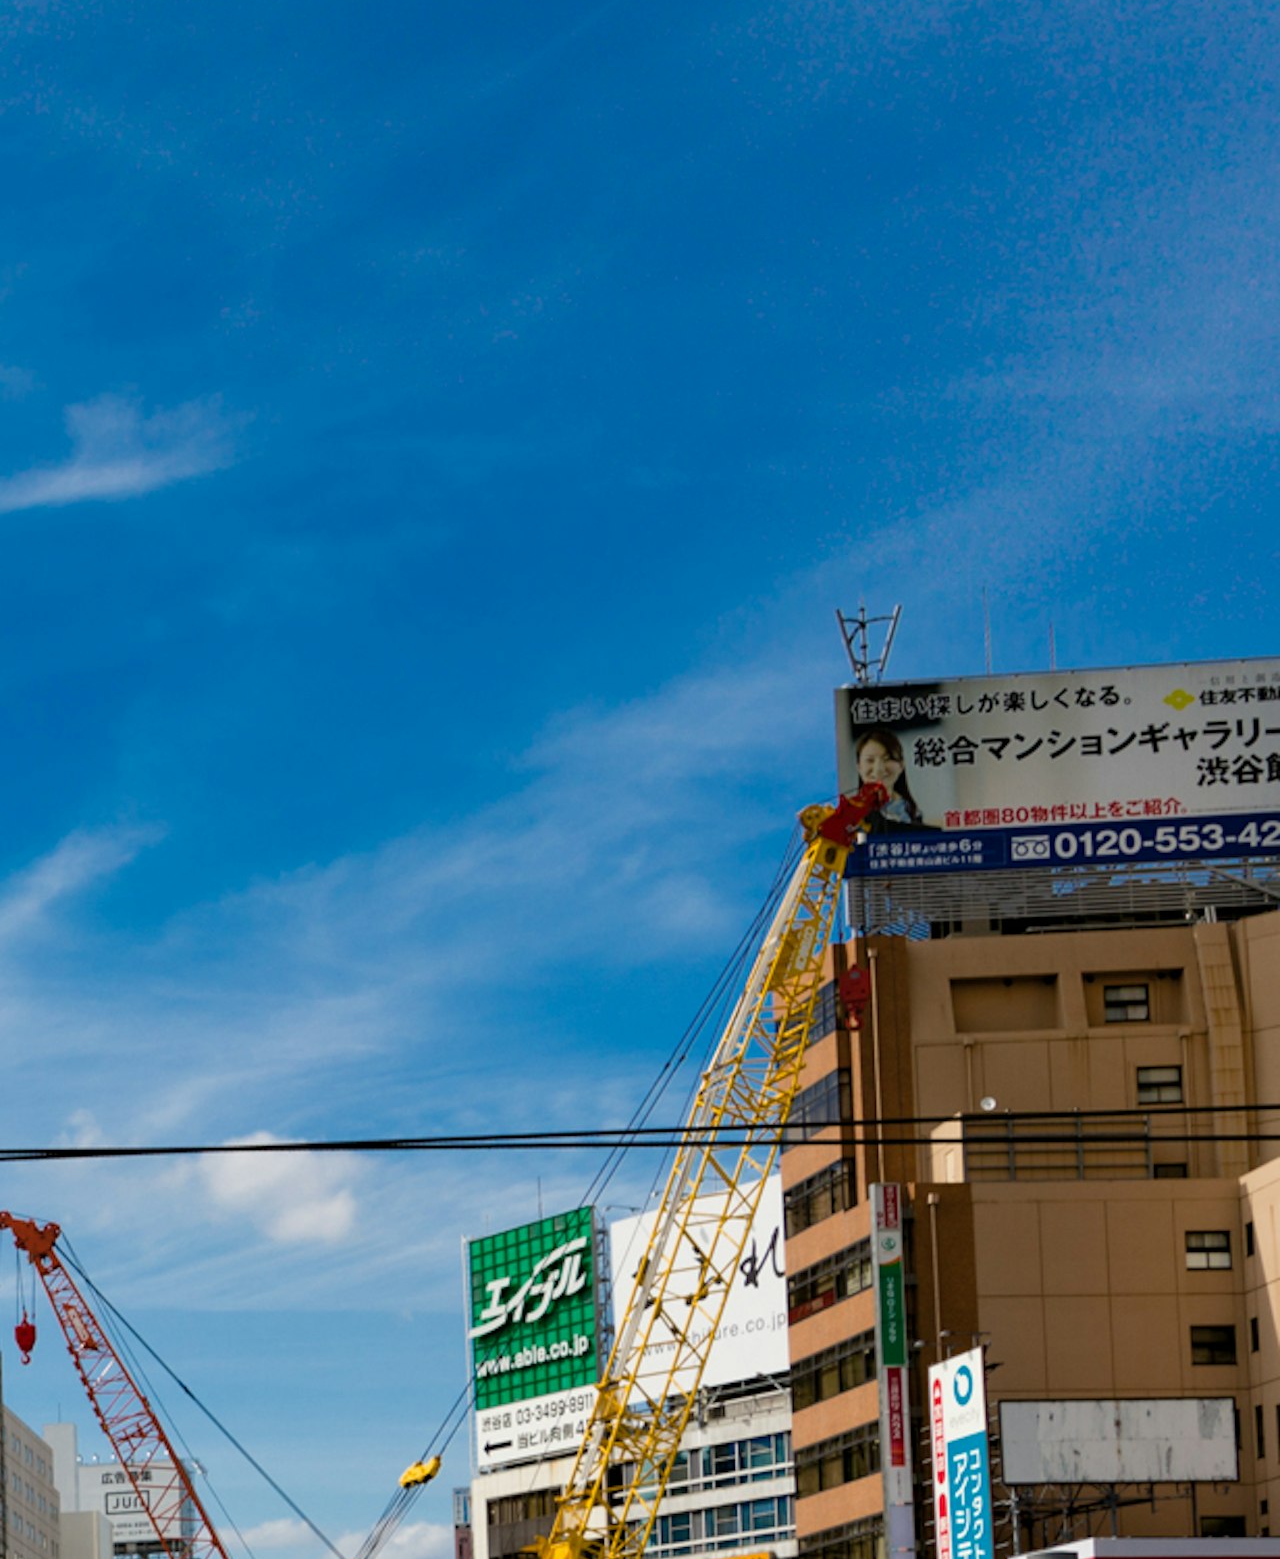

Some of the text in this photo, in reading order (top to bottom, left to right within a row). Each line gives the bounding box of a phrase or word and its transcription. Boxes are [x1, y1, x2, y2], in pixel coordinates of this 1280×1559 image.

[851, 686, 1132, 724] 住まい探しが楽しくなる。
[1200, 686, 1280, 706] 住友不動
[944, 797, 1188, 827] 首都圏80物件以上をご紹介。
[469, 1236, 587, 1339] エイブル
[476, 1333, 590, 1378] www.able.co.jp
